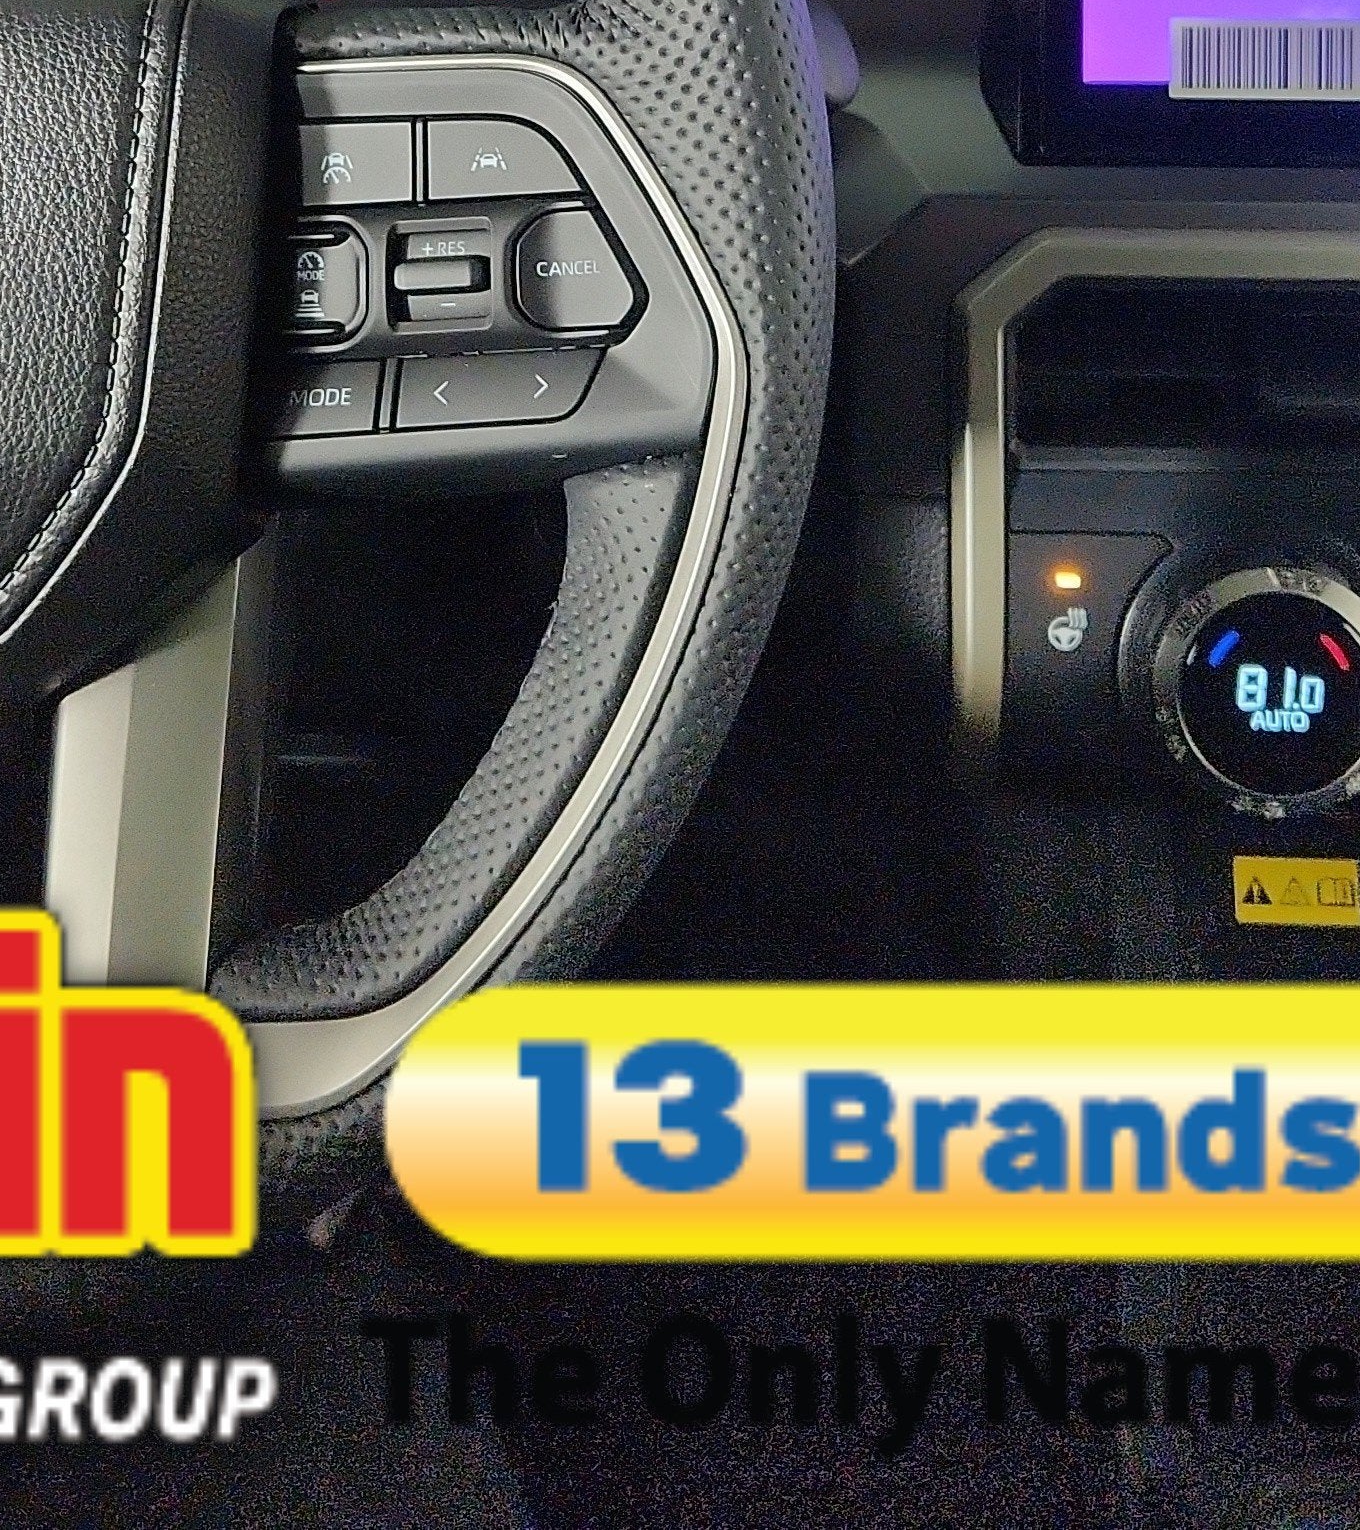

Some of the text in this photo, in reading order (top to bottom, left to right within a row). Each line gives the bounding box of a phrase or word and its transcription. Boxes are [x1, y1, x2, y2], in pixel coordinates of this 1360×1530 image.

[296, 270, 325, 282] MODE
[536, 260, 601, 277] CANCEL
[290, 387, 352, 408] MODE
[1236, 663, 1326, 714] 81.0
[1250, 710, 1310, 732] AUTO
